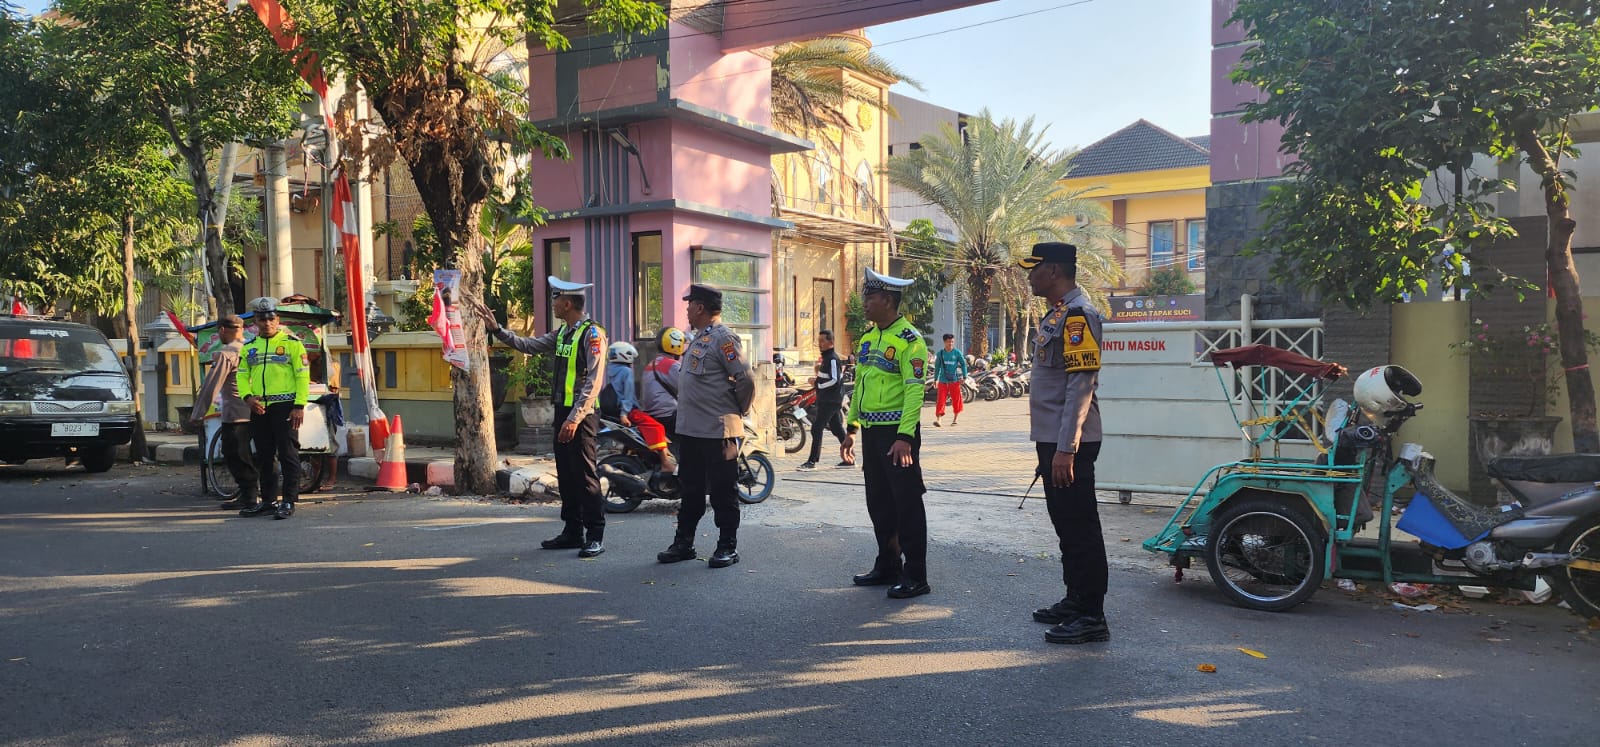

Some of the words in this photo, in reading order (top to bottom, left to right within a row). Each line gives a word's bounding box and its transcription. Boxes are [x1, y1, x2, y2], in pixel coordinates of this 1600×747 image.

[1102, 341, 1125, 351] INTU
[1128, 341, 1166, 351] MASUK
[1082, 352, 1097, 361] WIL
